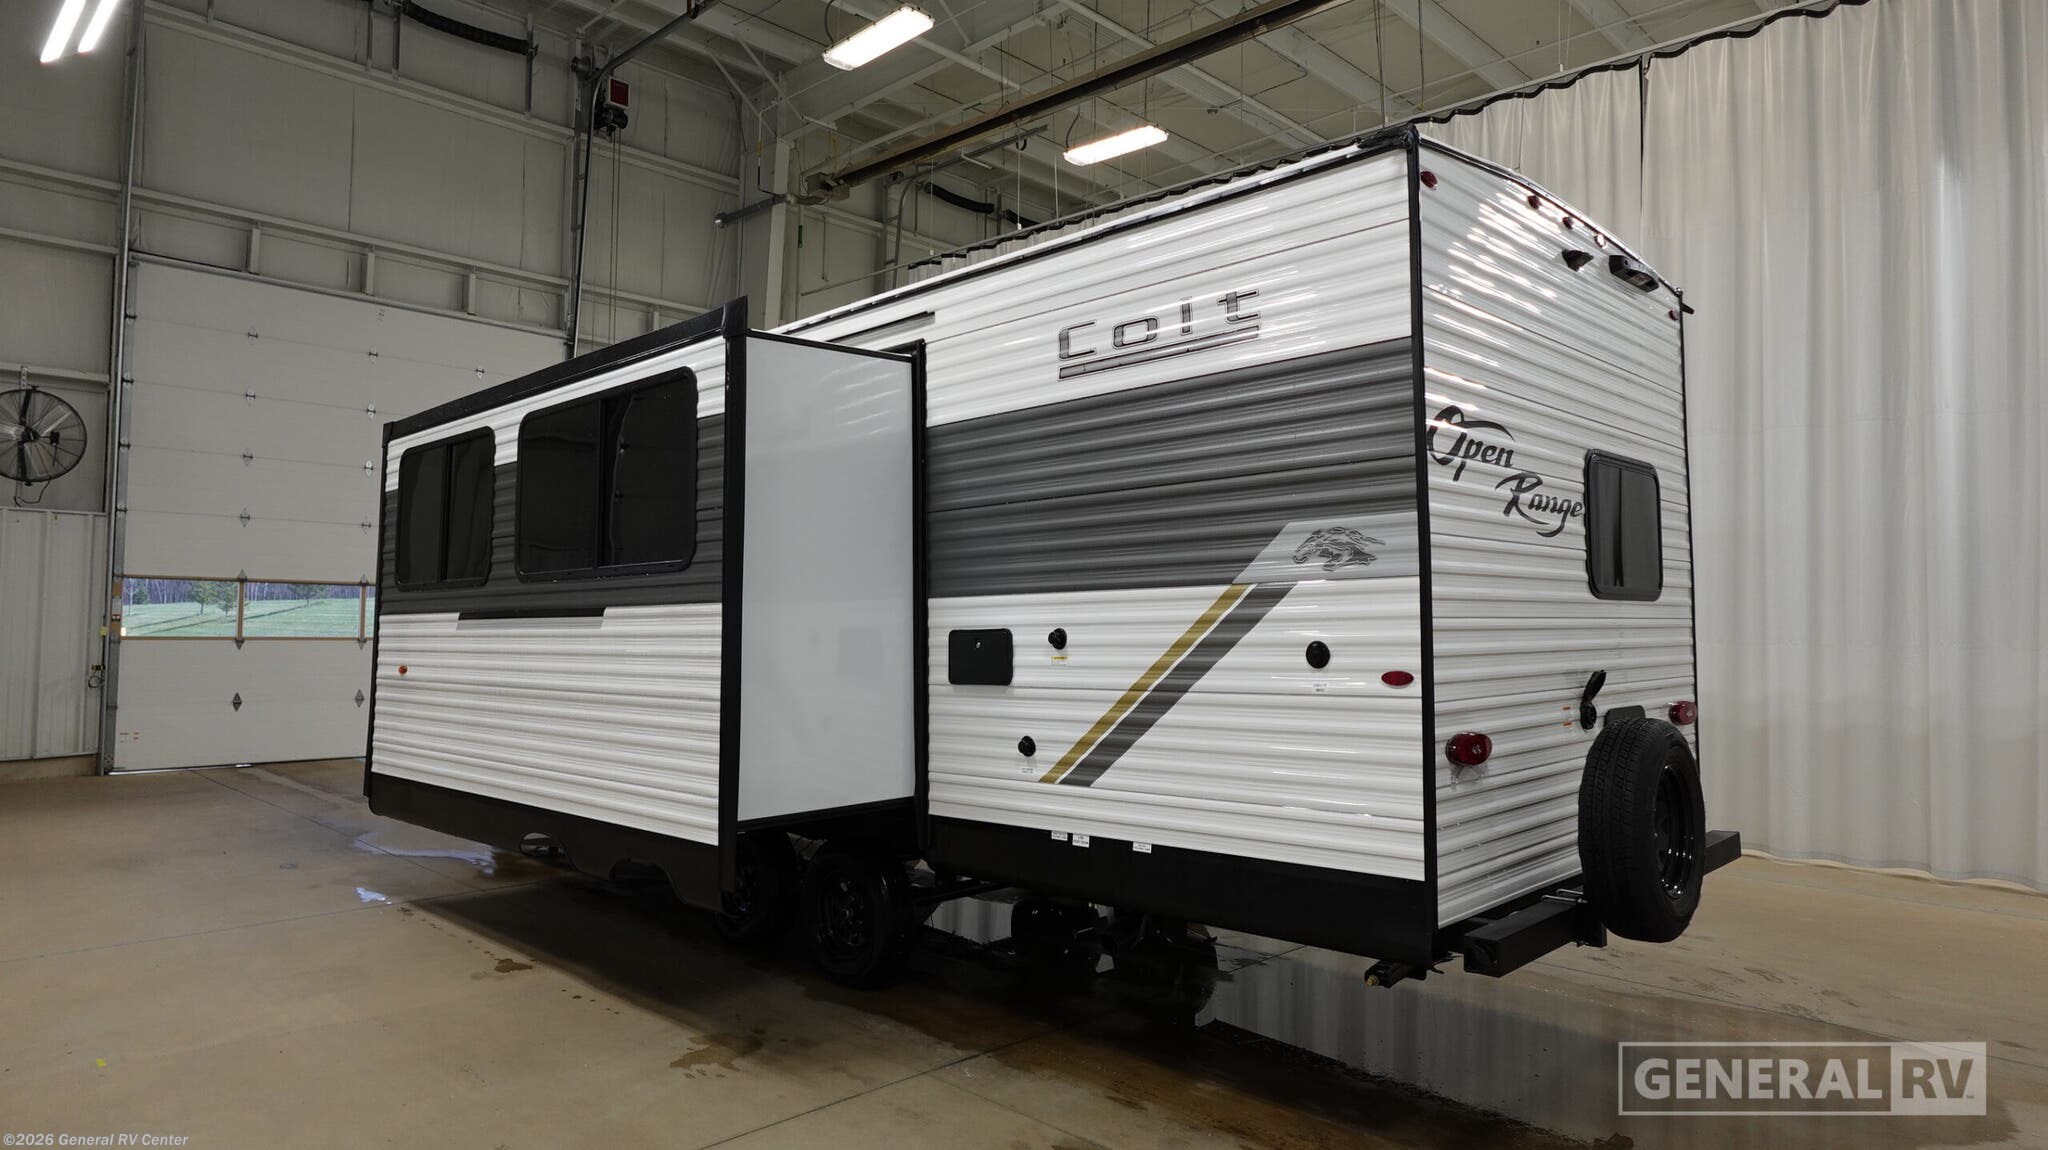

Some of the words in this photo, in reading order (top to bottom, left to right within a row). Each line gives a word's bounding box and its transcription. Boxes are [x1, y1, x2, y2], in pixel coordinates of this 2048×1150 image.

[1059, 290, 1260, 360] Colt
[1426, 405, 1516, 481] Open
[1495, 472, 1584, 537] Range
